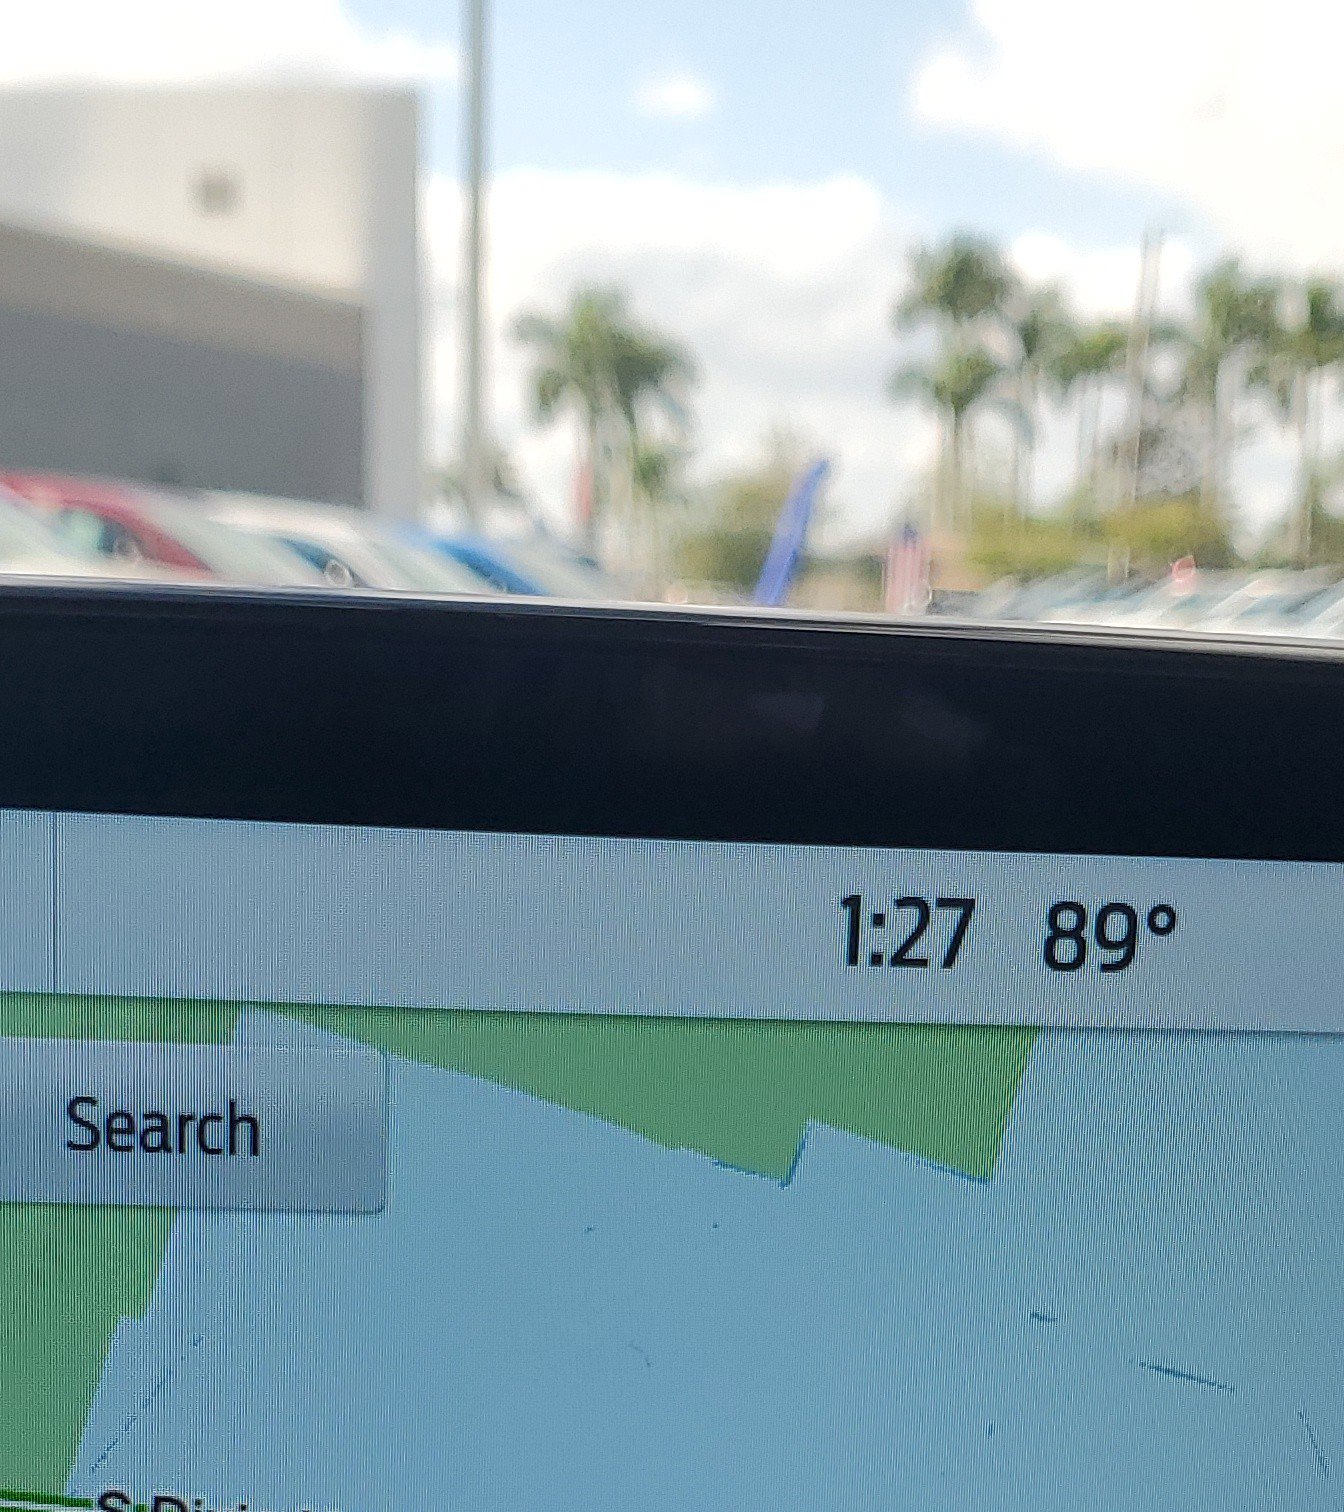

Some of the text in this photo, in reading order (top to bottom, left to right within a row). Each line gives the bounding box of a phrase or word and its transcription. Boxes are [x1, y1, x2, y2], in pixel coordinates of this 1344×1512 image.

[840, 894, 976, 969] 1:27
[1043, 900, 1179, 972] 89°
[65, 1096, 261, 1157] Search
